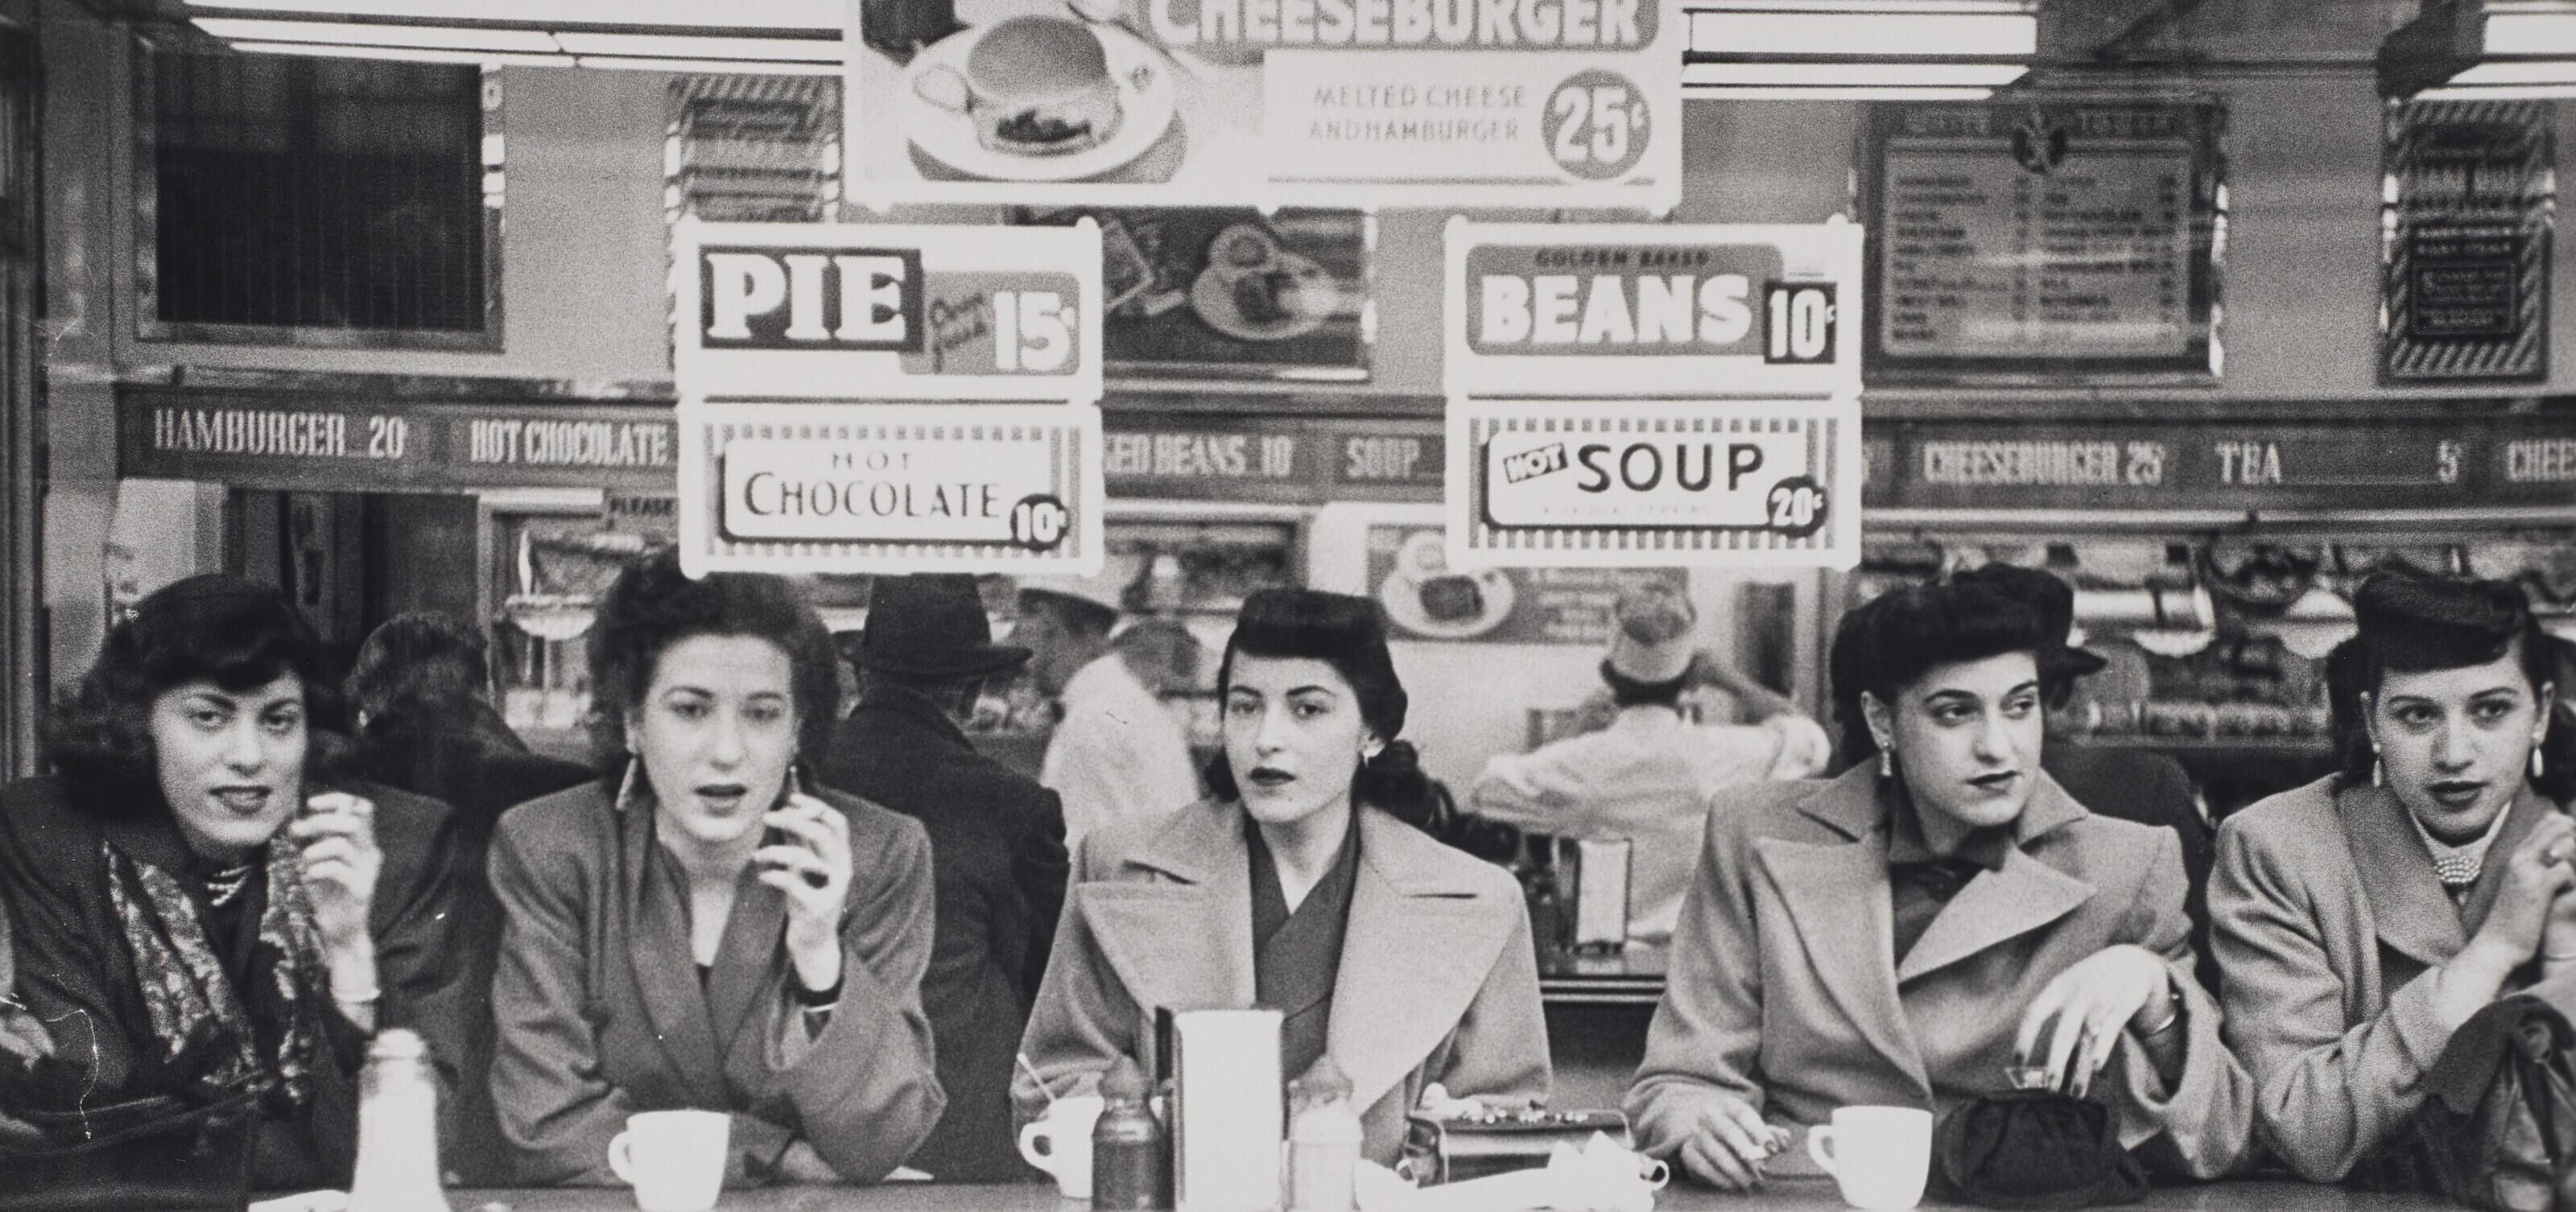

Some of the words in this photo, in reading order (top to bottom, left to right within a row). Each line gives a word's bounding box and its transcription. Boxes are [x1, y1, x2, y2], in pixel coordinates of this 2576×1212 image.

[1150, 0, 1640, 43] CHEESEBURGER
[1314, 84, 1417, 109] MELTED
[1426, 84, 1526, 109] CHEESE
[1534, 249, 1629, 267] GOLDEN
[706, 254, 906, 341] PIE
[1481, 274, 1753, 344] BEANS
[155, 406, 345, 457] HAMBURGER
[471, 419, 522, 464] HOT
[526, 420, 667, 465] CHOCOLATE
[832, 451, 911, 471] HOT
[1154, 435, 1246, 476] BEANS
[1347, 438, 1419, 478] SOUP
[1505, 443, 1566, 481] HOT
[1577, 443, 1764, 493] SOUP
[1925, 440, 2119, 484] CHEESEBURGER
[2215, 441, 2282, 483] TEA
[744, 471, 1001, 517] CHOCOLATE
